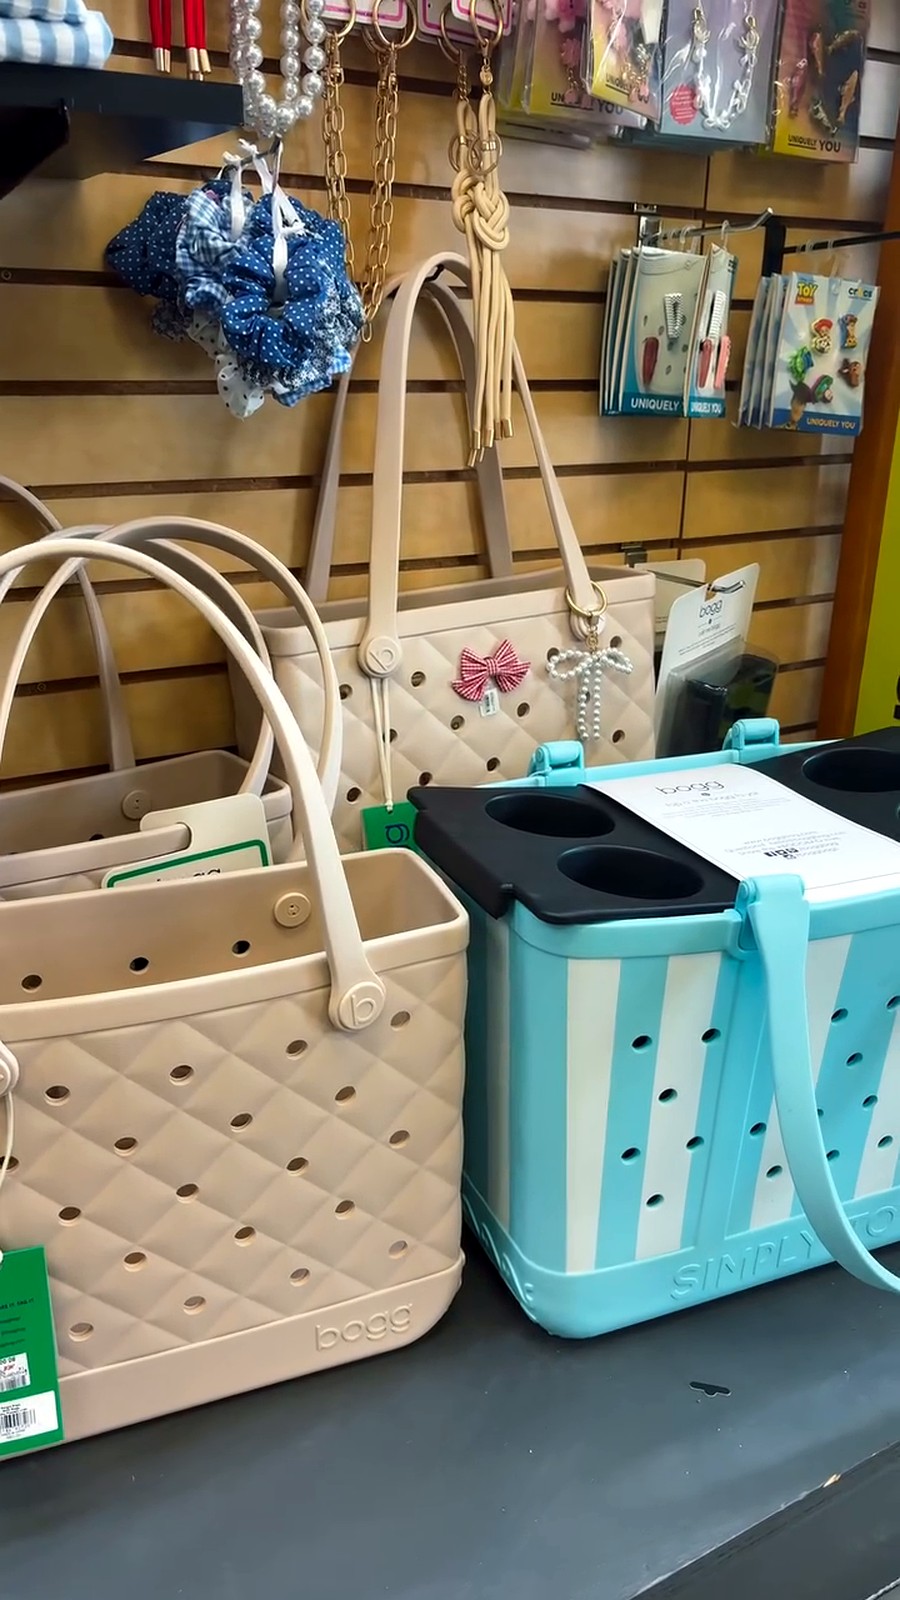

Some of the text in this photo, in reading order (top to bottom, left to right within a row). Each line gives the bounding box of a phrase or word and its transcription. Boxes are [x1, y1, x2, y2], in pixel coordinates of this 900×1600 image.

[788, 134, 841, 153] UNIQUELY YOU
[797, 282, 818, 297] TOY
[630, 397, 680, 411] UNIQUELY
[806, 417, 856, 430] UNIQUELY YOU
[699, 599, 723, 618] bogg
[655, 780, 725, 795] bogg
[350, 993, 378, 1027] b
[670, 1229, 815, 1300] SIMPLY
[315, 1303, 413, 1352] bogg
